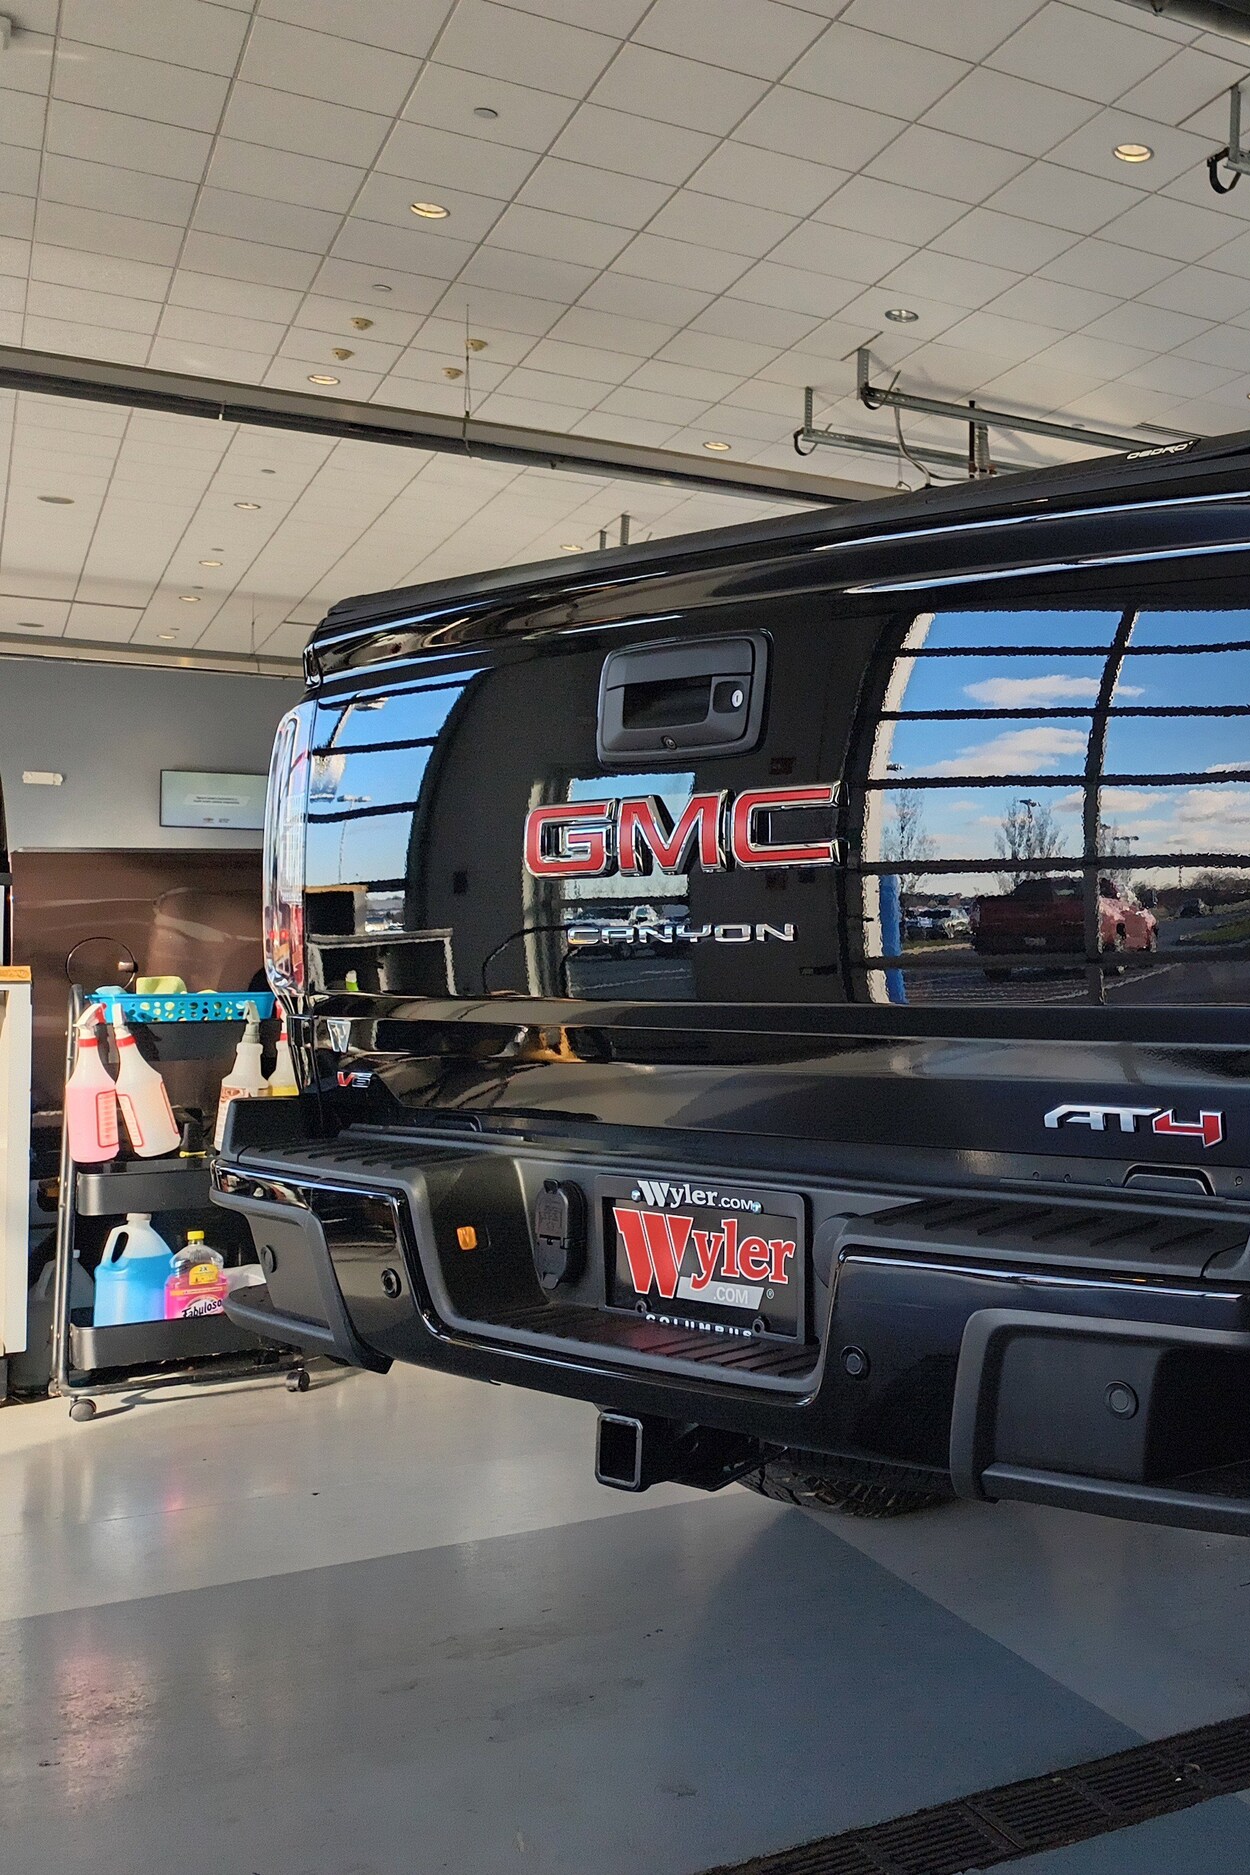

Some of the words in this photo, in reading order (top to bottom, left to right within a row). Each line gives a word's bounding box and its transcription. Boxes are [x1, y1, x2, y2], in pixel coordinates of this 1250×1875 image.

[523, 780, 850, 880] GMC
[566, 922, 798, 946] CANYON
[337, 1071, 373, 1089] V6
[1043, 1104, 1224, 1149] AT4
[612, 1206, 796, 1300] Wyler
[181, 1299, 223, 1319] Fabuloso
